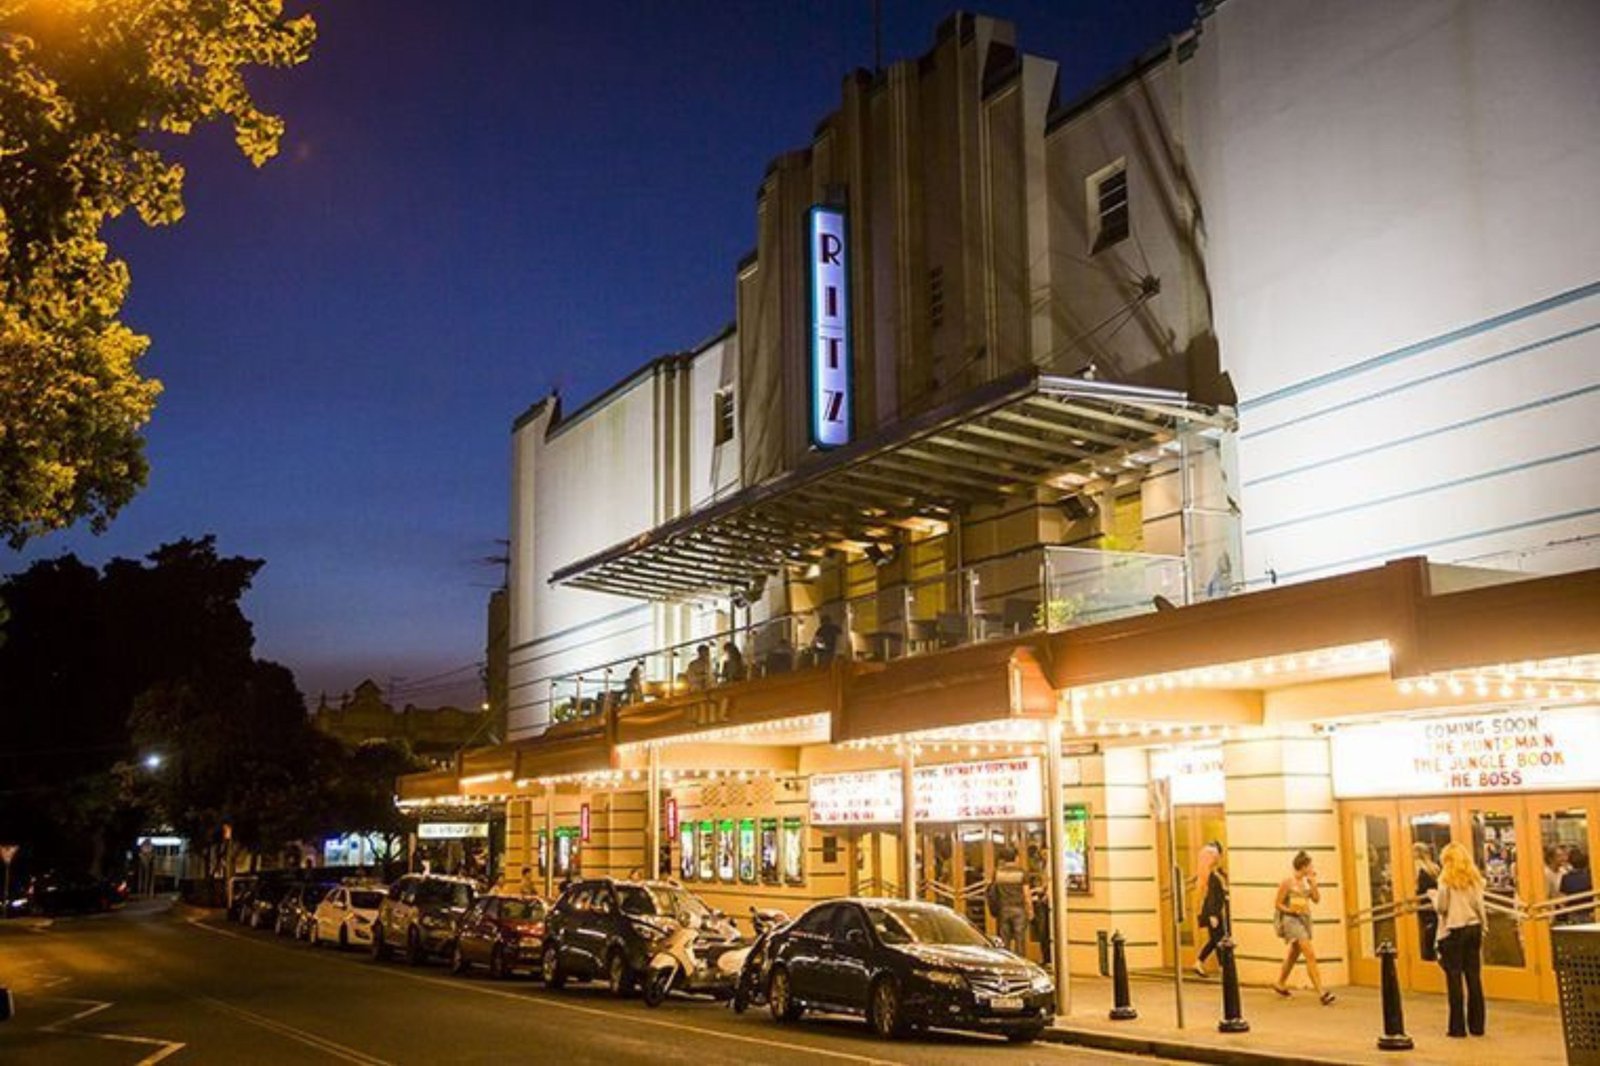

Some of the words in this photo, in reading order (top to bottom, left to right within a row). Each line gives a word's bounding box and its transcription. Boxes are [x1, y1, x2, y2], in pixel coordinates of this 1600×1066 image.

[820, 233, 844, 424] RITZ
[1425, 720, 1485, 739] COMING
[1492, 716, 1538, 734] SOON
[1449, 752, 1507, 771] JUNGLE
[1517, 751, 1564, 769] BOOK
[1478, 769, 1524, 788] BOSS
